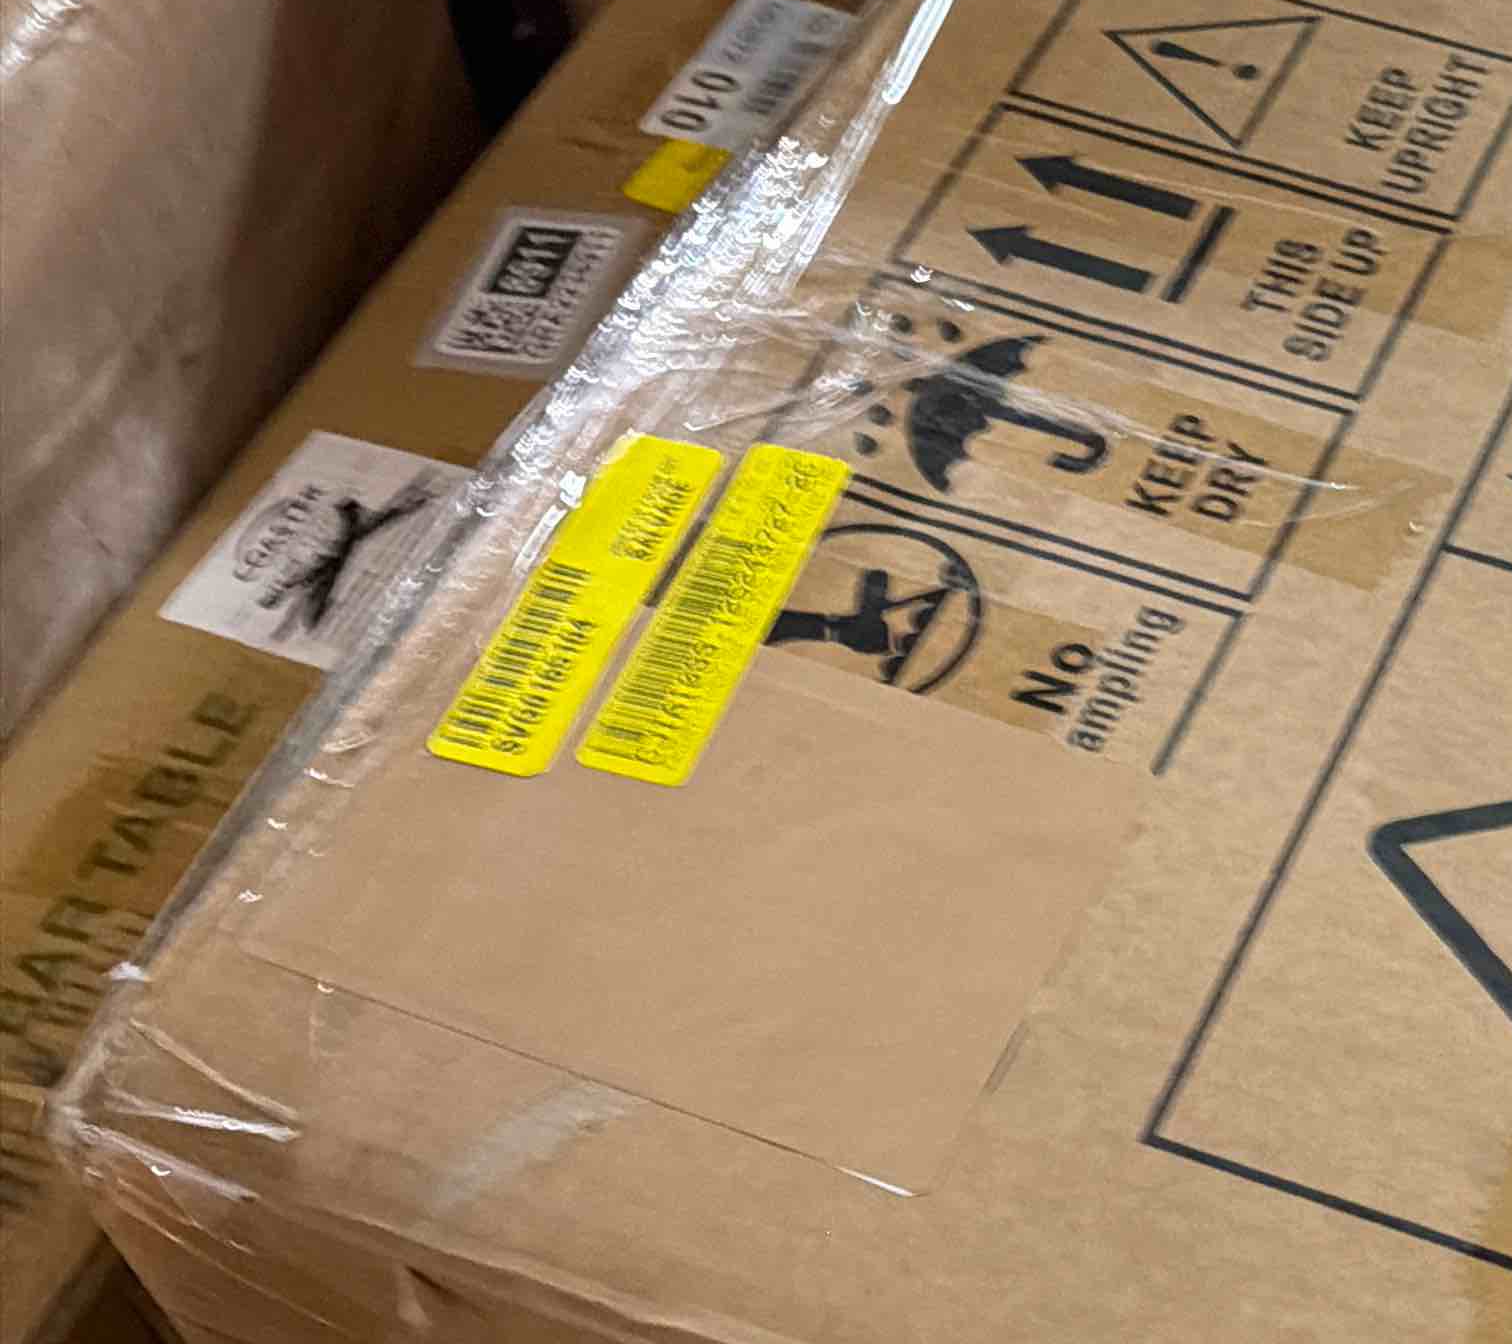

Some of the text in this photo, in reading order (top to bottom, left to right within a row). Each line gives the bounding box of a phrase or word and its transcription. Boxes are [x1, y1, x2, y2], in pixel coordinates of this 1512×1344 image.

[1345, 65, 1418, 154] KEEP
[1379, 51, 1491, 196] UPRIGHT
[1239, 238, 1325, 315] THIS
[1282, 227, 1390, 362] SIDE UP
[1125, 412, 1217, 517] KEEP
[1191, 441, 1268, 524] DRY
[1009, 641, 1096, 715] No
[1066, 605, 1186, 753] ampling
